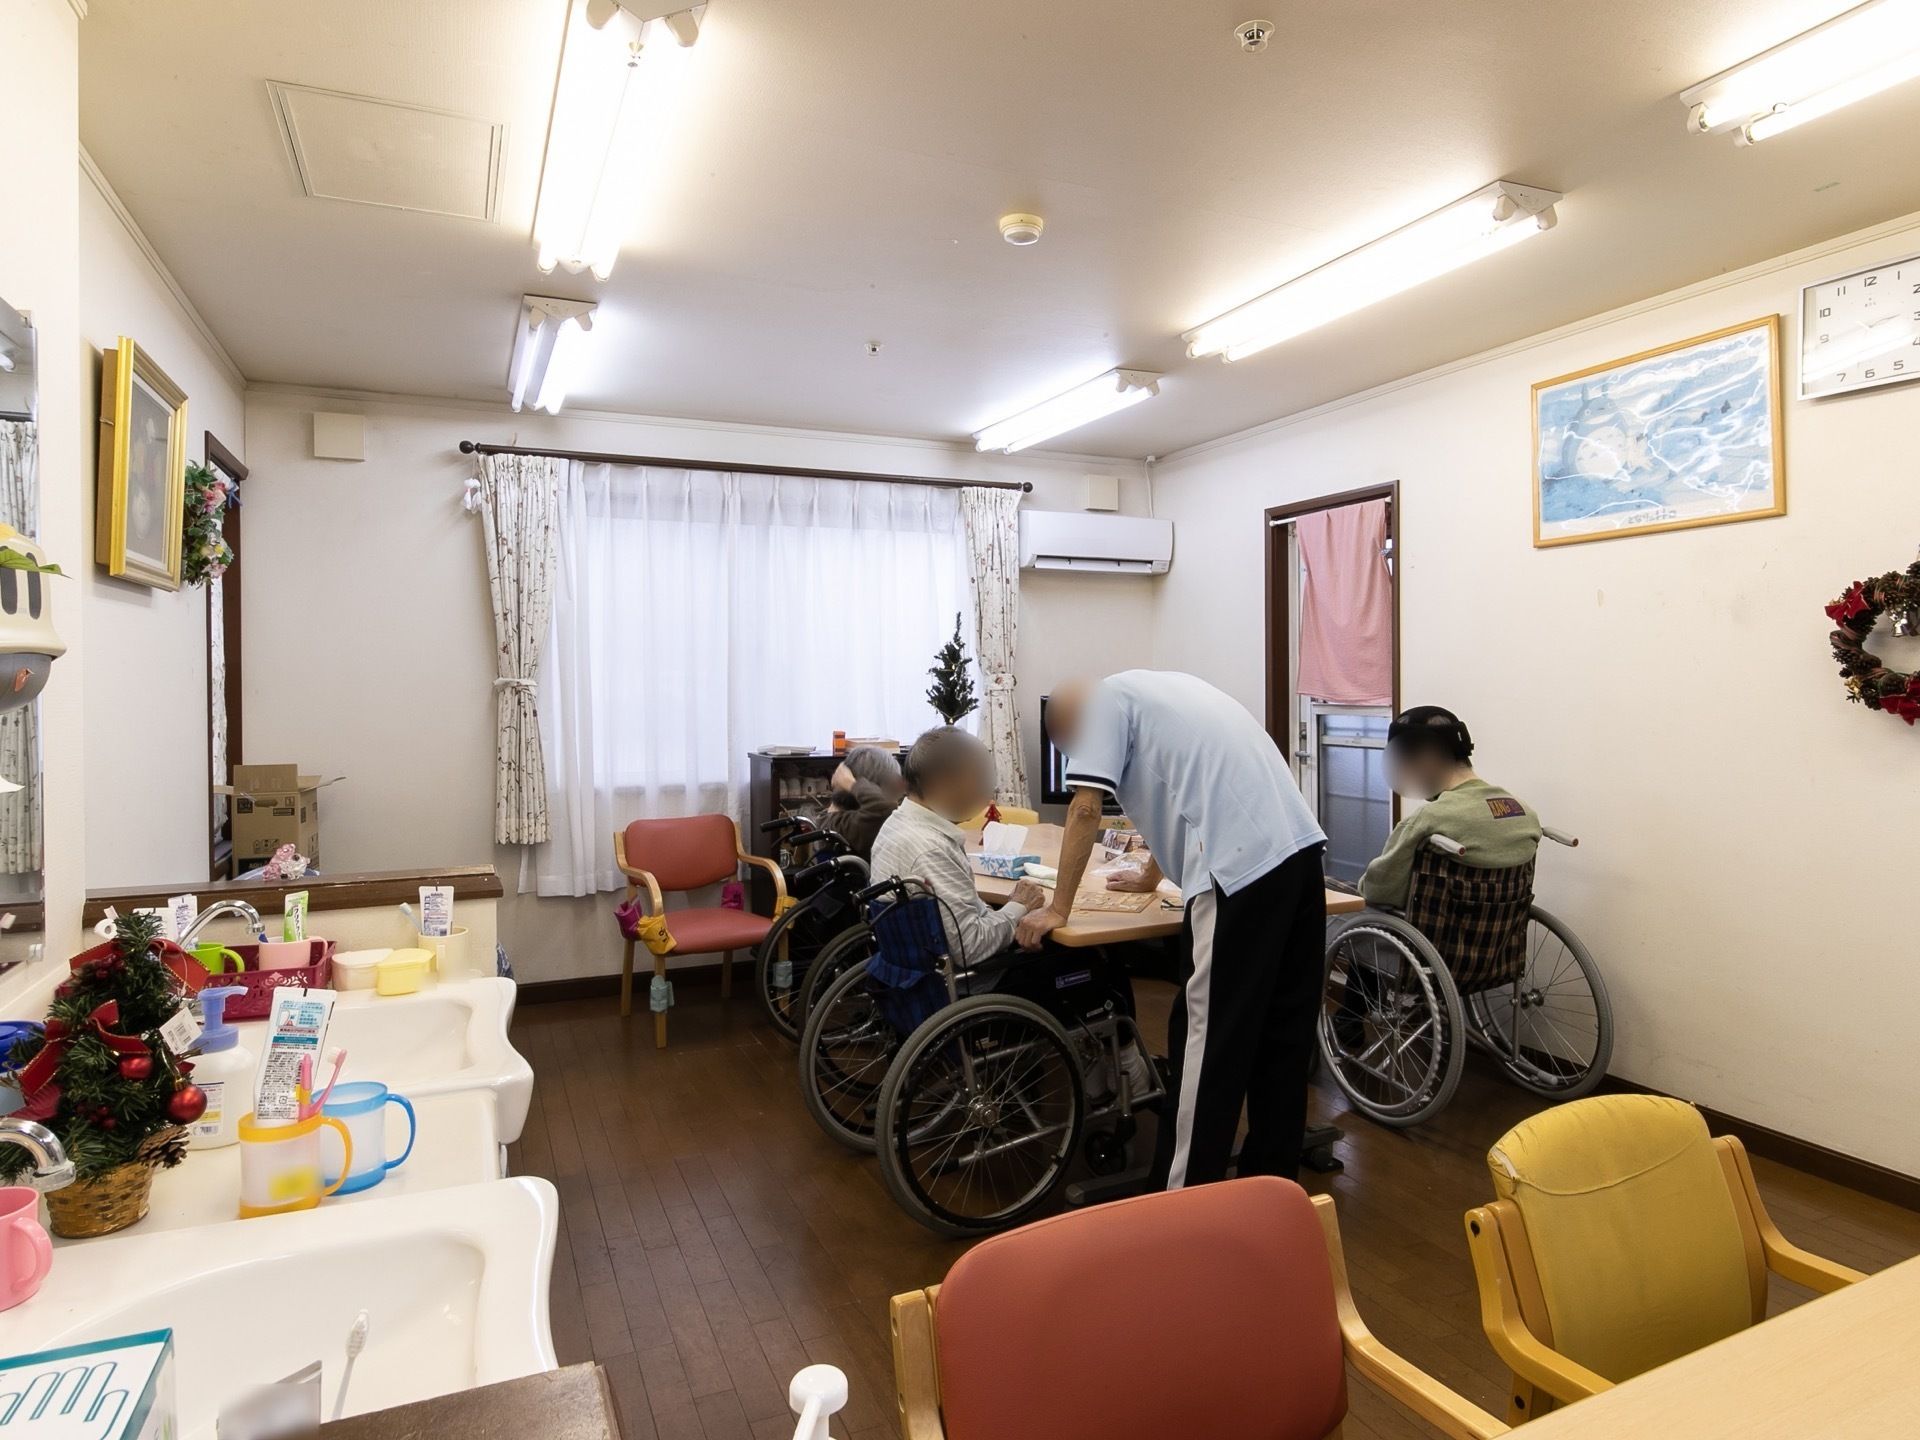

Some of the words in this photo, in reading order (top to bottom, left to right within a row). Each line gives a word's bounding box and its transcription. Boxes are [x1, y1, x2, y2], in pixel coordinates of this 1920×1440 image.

[1863, 276, 1878, 288] 12
[1837, 286, 1846, 297] 11
[1820, 308, 1831, 318] 10
[1820, 334, 1829, 343] 9
[1893, 360, 1904, 371] 5
[1836, 373, 1847, 382] 7
[1865, 369, 1875, 378] 6
